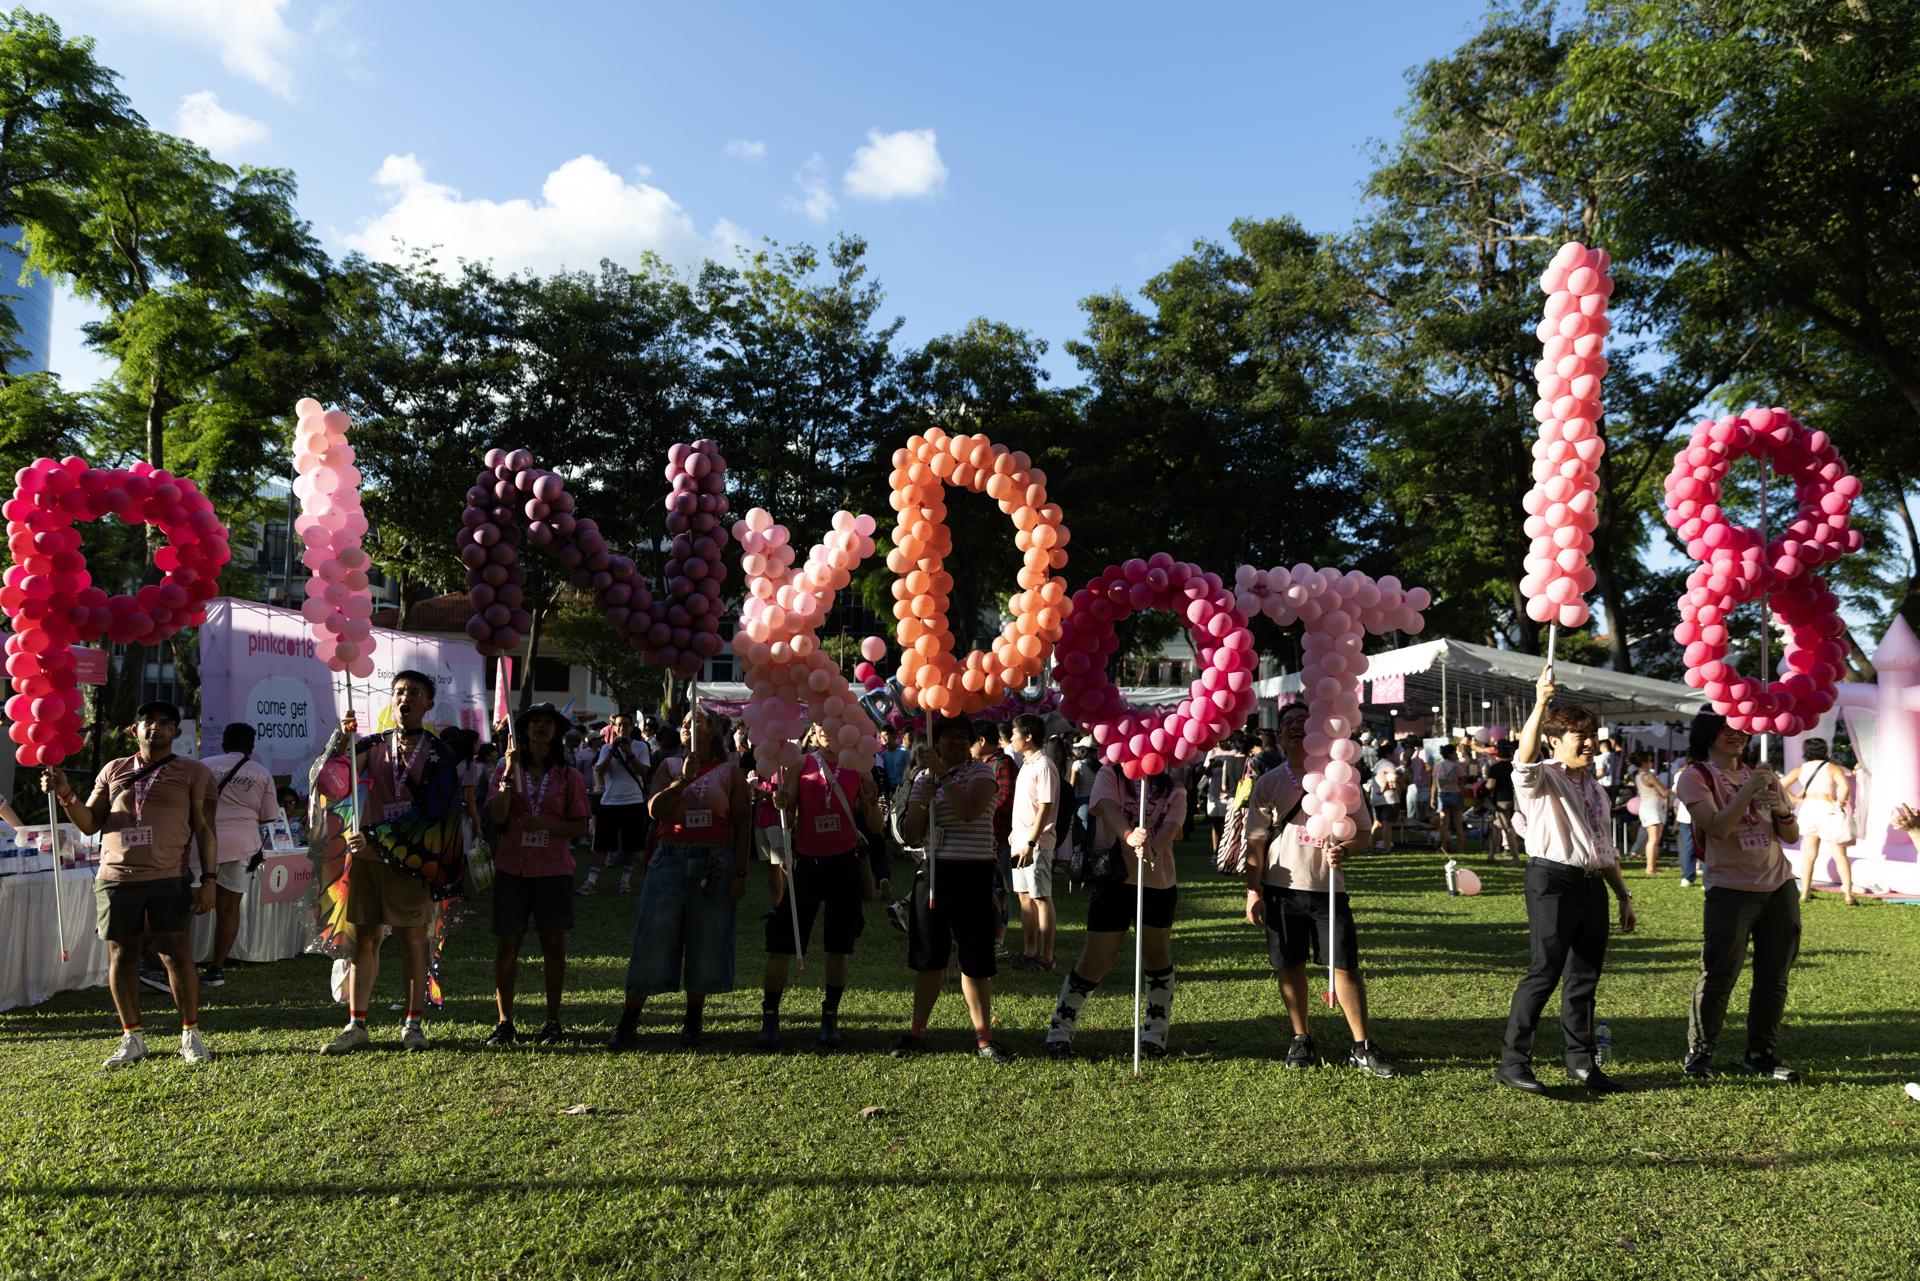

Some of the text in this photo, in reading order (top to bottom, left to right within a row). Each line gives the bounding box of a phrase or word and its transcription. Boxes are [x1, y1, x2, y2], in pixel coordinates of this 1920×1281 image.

[257, 700, 308, 720] come get
[257, 719, 309, 741] personal
[294, 869, 311, 881] Info
